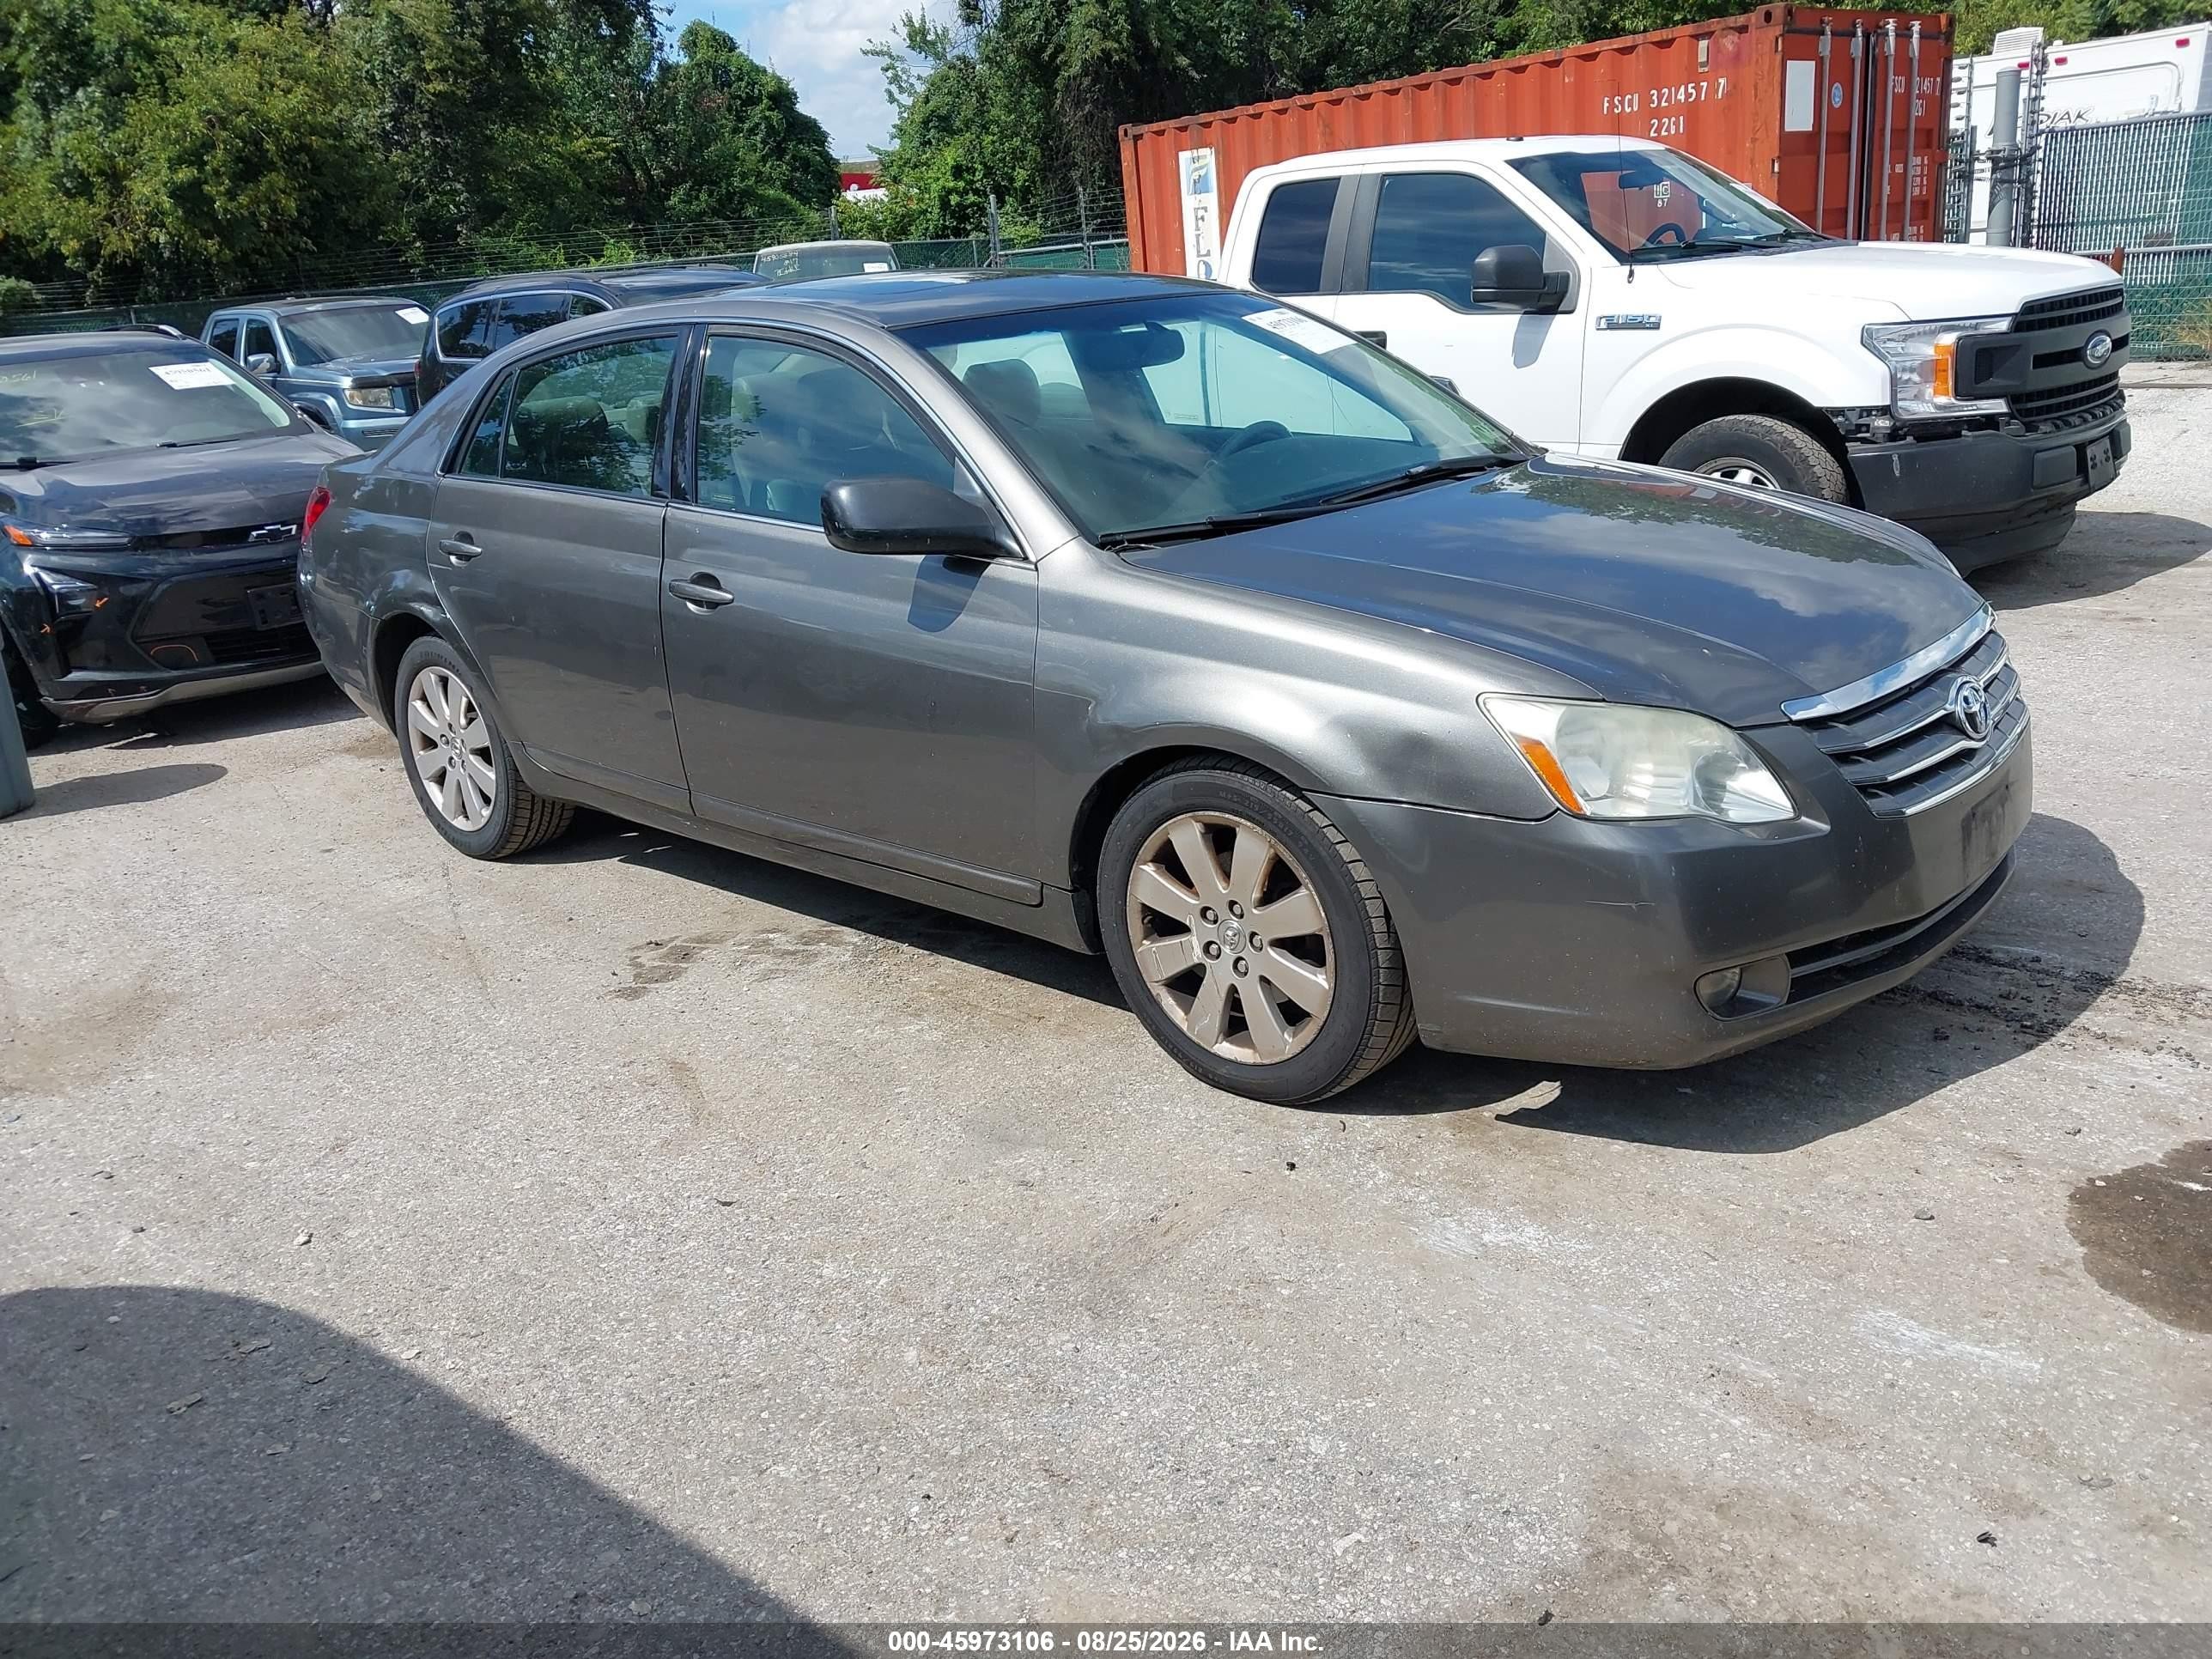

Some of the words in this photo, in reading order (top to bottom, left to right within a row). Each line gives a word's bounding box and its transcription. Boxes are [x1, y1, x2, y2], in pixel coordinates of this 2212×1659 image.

[1916, 76, 1933, 94] 21457
[1603, 93, 1639, 115] FSCU
[1649, 82, 1708, 108] 321457
[1657, 198, 1669, 208] 87
